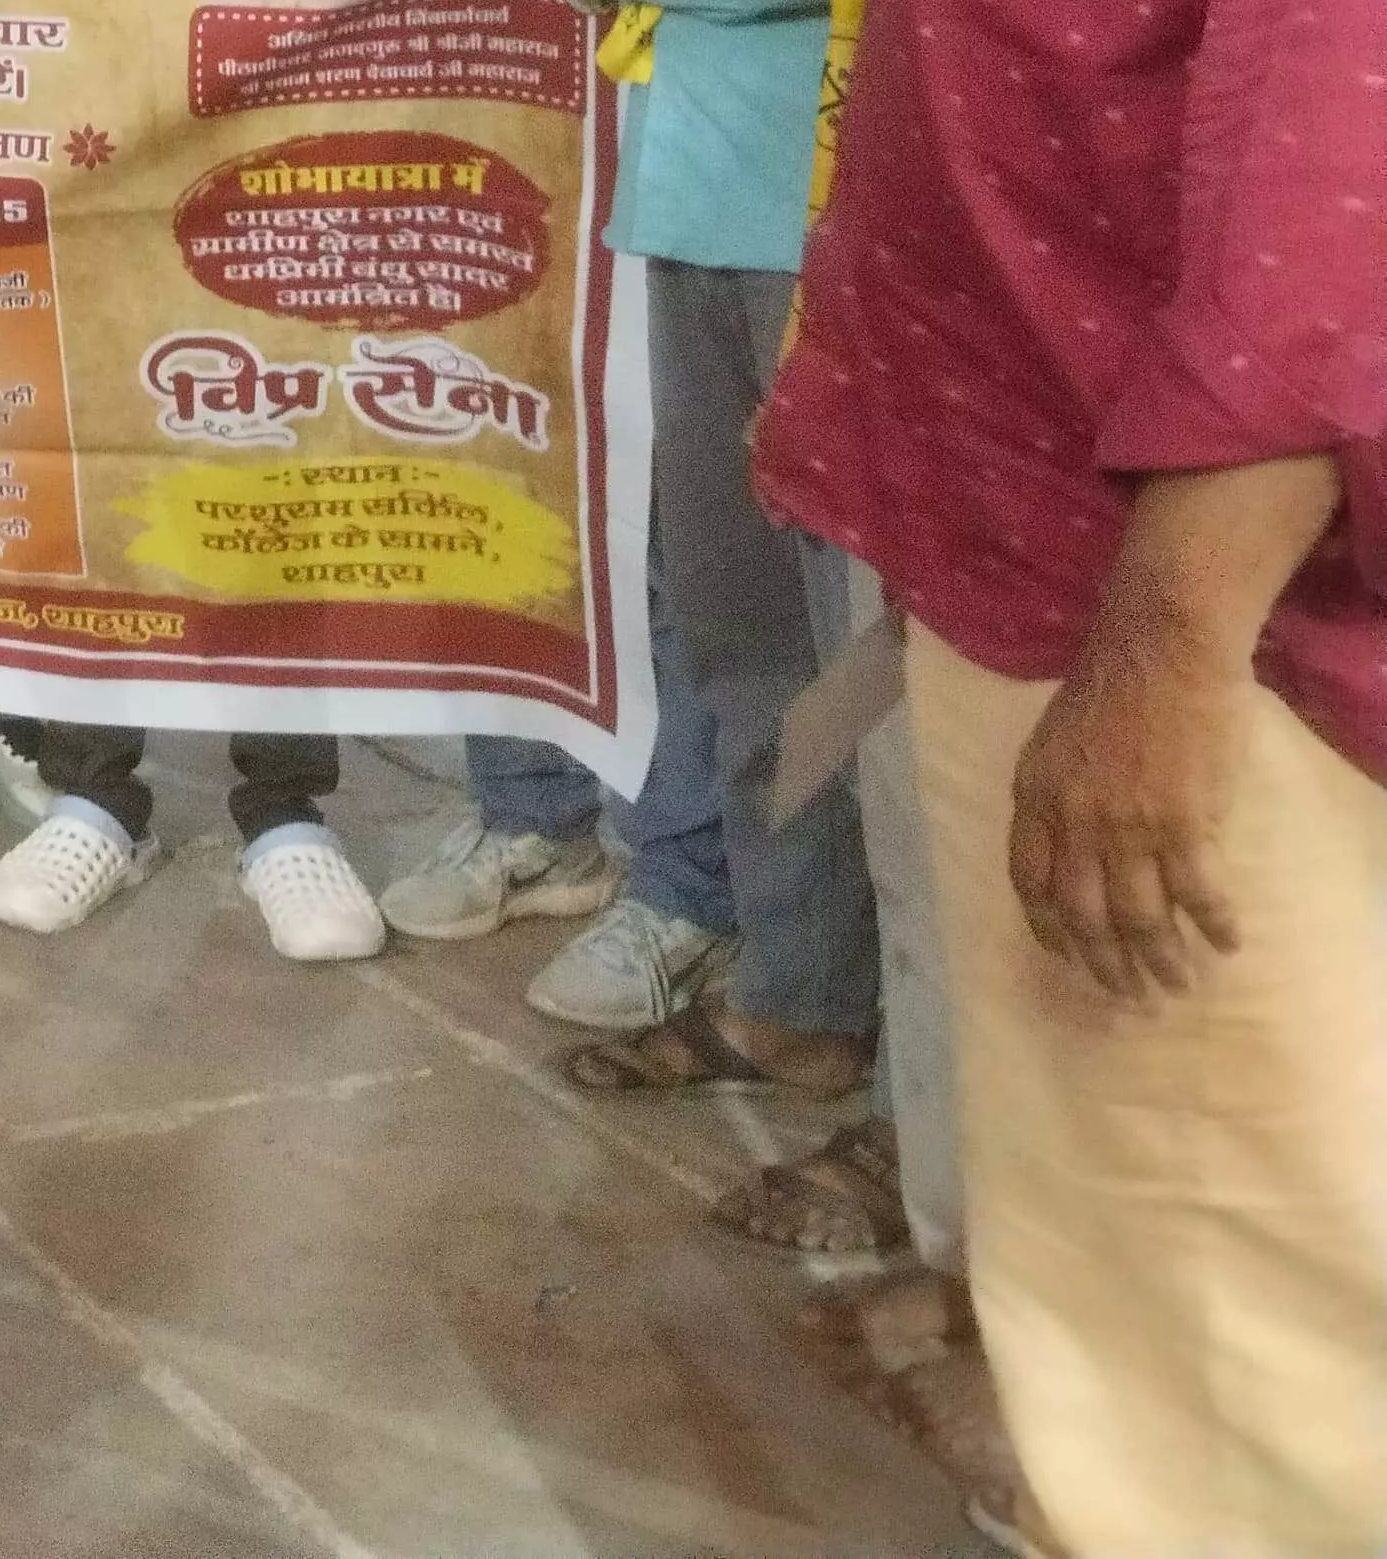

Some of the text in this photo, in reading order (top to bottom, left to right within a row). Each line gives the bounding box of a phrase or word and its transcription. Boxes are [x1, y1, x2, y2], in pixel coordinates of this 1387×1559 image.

[240, 157, 491, 195] शोभायात्रा में
[147, 336, 545, 445] विप्र सेना
[300, 465, 402, 486] स्थान
[195, 498, 354, 528] परशुराम
[330, 523, 370, 549] के
[282, 562, 426, 590] शाहपुरा
